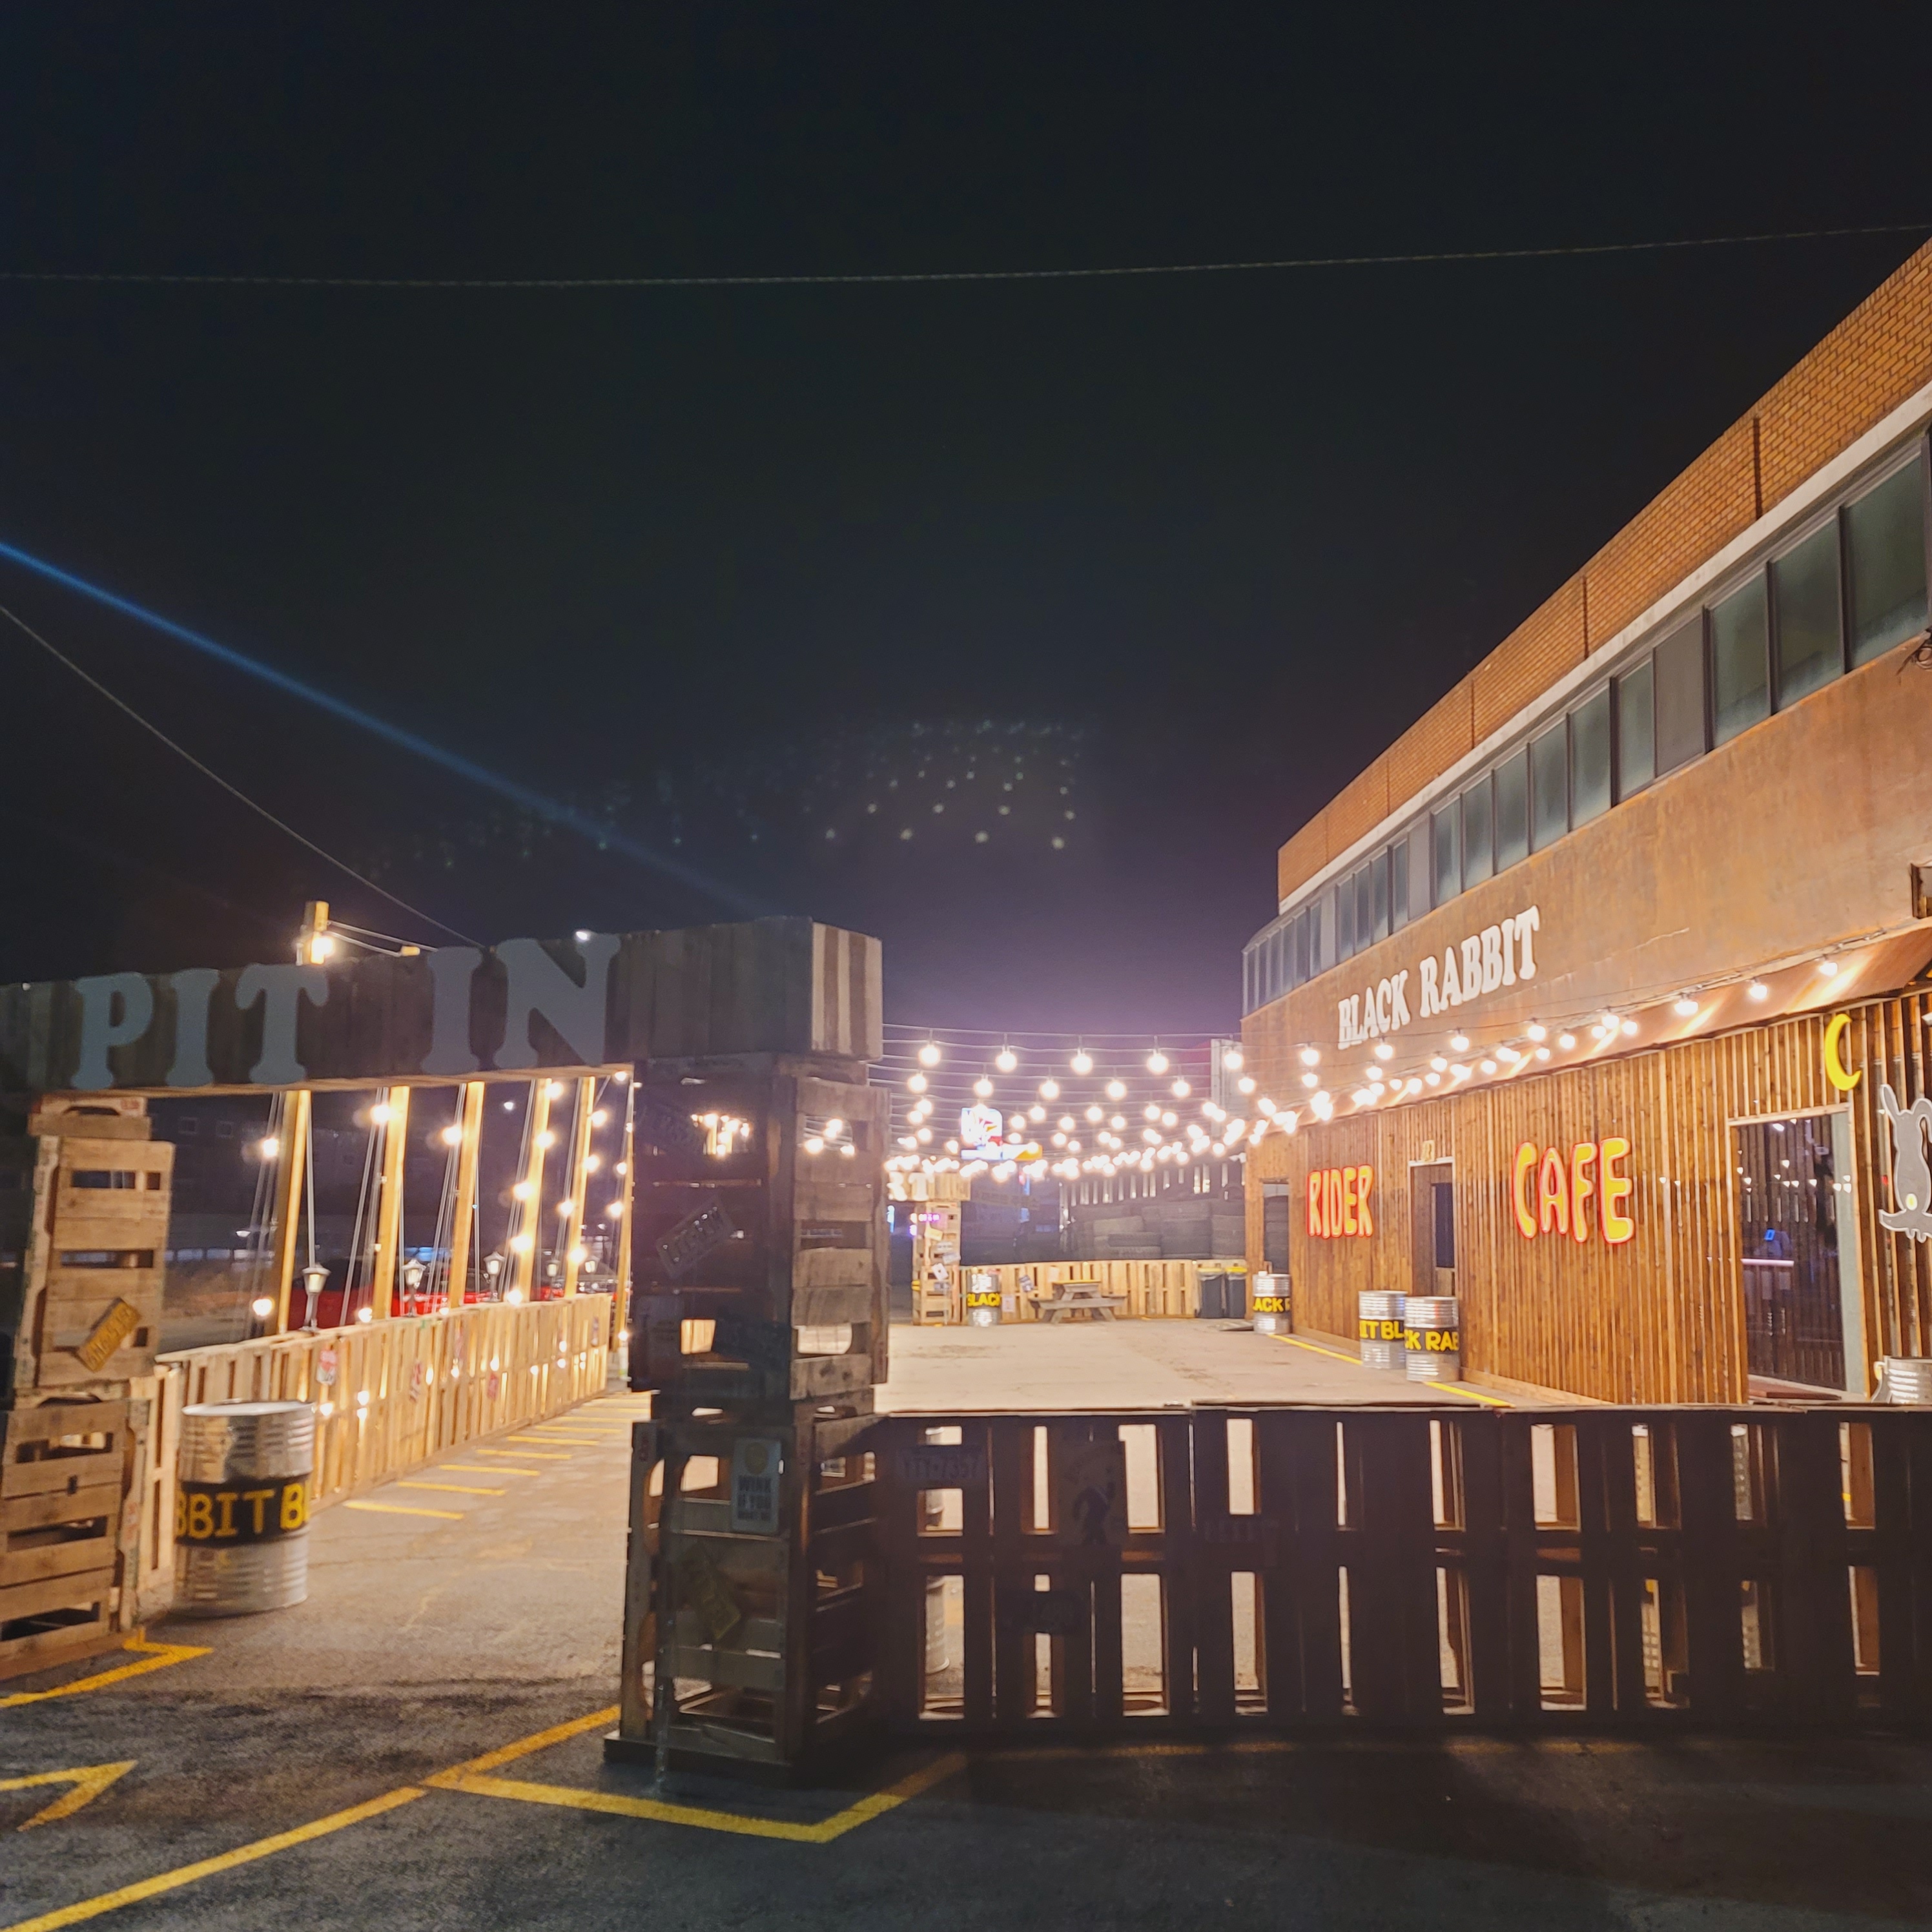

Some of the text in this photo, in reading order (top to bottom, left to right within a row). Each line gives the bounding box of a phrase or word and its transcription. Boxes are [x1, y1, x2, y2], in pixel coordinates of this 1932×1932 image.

[70, 932, 622, 1091] PIT IN
[1337, 905, 1541, 1050] BLACK RABBIT
[1306, 1164, 1373, 1239] RIDER
[1512, 1136, 1635, 1244] CAFE
